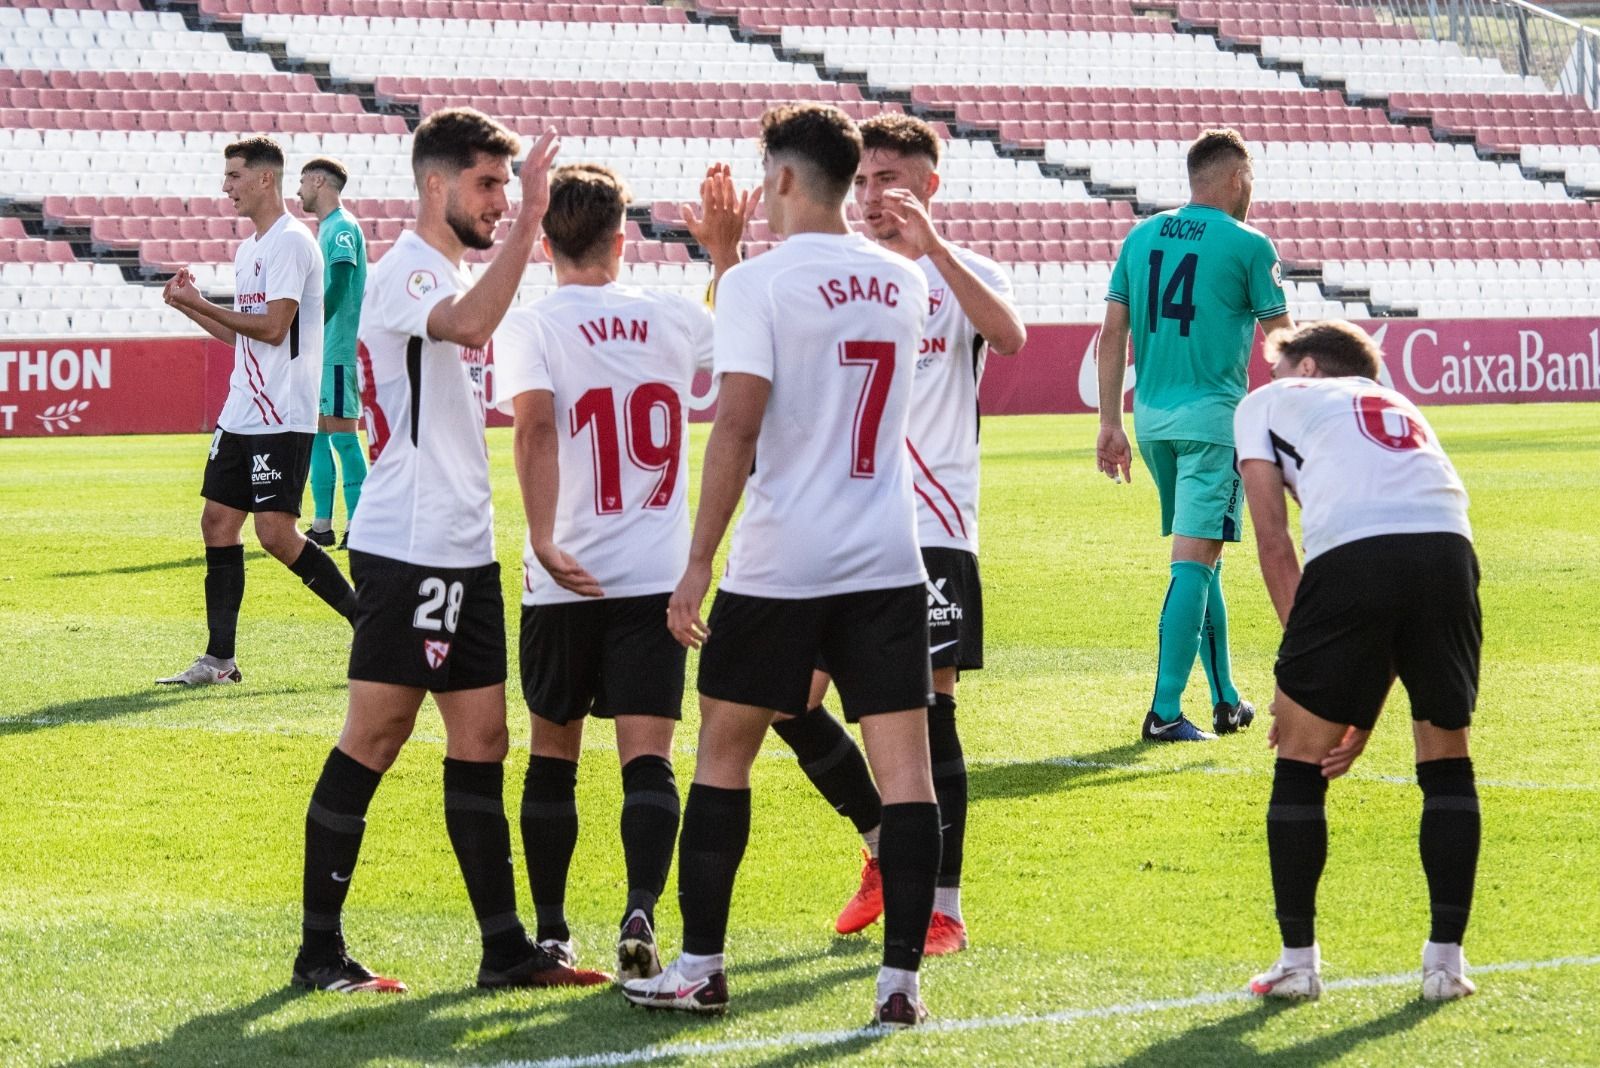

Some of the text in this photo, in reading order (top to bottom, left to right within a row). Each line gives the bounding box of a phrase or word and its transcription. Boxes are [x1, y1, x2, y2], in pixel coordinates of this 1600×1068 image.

[1160, 217, 1207, 242] BOCHA
[818, 275, 900, 310] ISAAC
[1148, 249, 1199, 337] 14
[578, 316, 648, 346] IVAN
[1402, 328, 1600, 395] CaixaBank
[838, 341, 896, 479] 7
[1353, 396, 1427, 453] 6
[251, 469, 281, 481] everfx
[569, 382, 682, 515] 19
[1227, 479, 1240, 513] GIOS
[412, 576, 464, 634] 28
